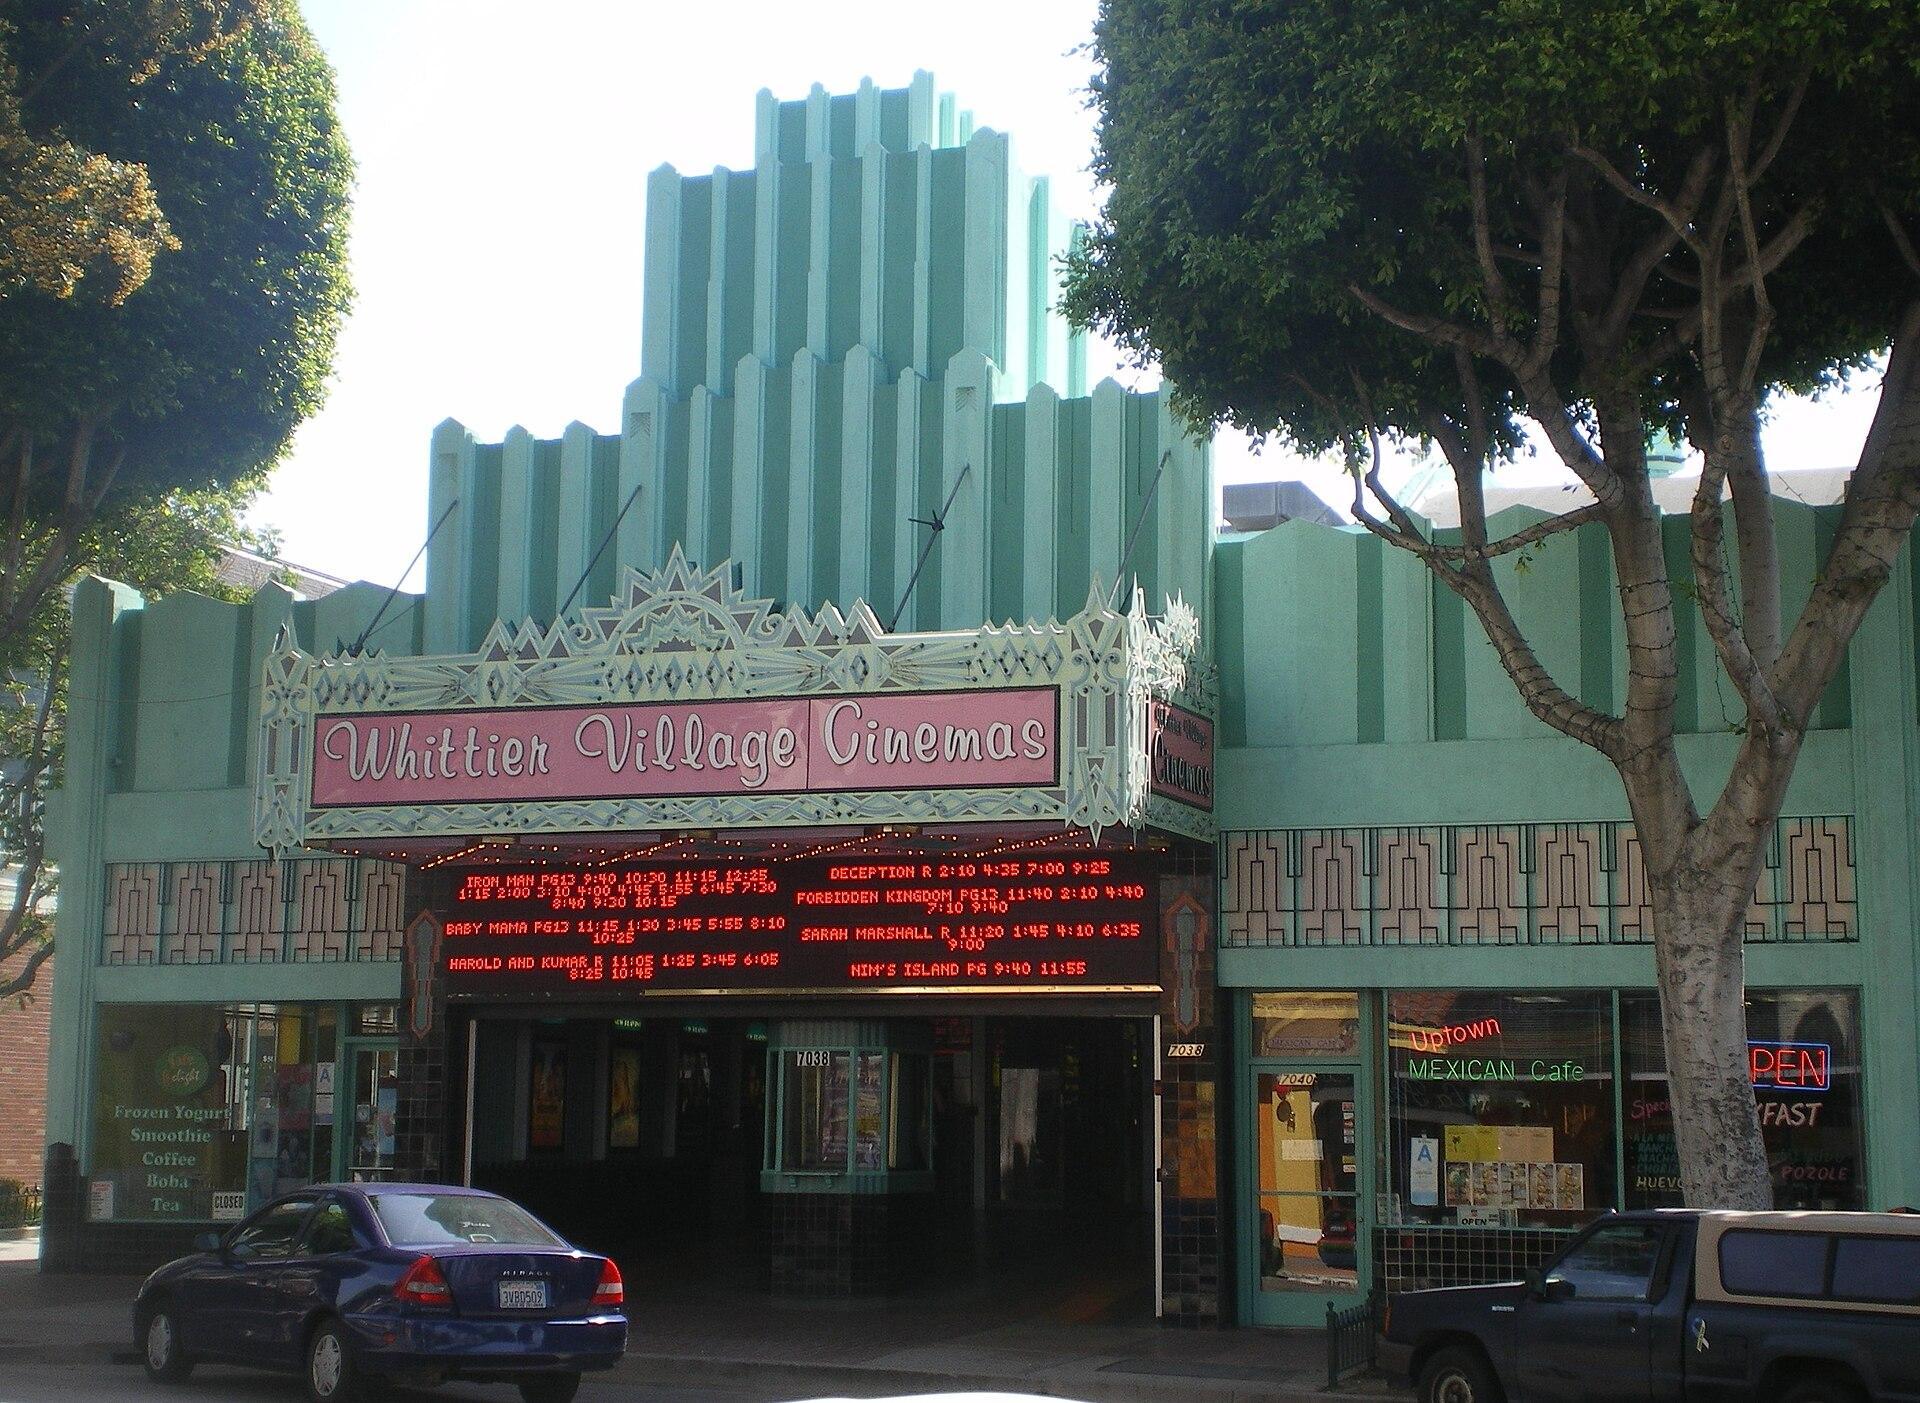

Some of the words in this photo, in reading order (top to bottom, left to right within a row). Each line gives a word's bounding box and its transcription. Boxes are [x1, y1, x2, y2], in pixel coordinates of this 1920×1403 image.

[323, 720, 549, 781] Whittier
[574, 713, 796, 788] Village
[823, 700, 1048, 765] Cinemas
[1154, 730, 1212, 797] Cinemas
[467, 876, 499, 888] IRON
[507, 875, 534, 887] MAN
[541, 874, 576, 886] PG13
[584, 873, 617, 885] 9:40
[625, 872, 666, 884] 10:30
[675, 870, 717, 882] 11:15
[726, 869, 768, 881] 12:25
[830, 866, 915, 880] DECEPTION
[921, 866, 932, 878] R
[939, 865, 976, 878] 2:10
[983, 864, 1020, 876] 4:35
[1026, 862, 1065, 875] 7:00
[1072, 861, 1110, 875] 9:25
[459, 888, 491, 899] 1:15
[498, 888, 530, 899] 2:00
[537, 886, 570, 898] 3:10
[577, 885, 610, 897] 4:00
[617, 884, 652, 896] 4:45
[659, 883, 693, 895] 5:55
[700, 882, 735, 894] 6:45
[742, 881, 777, 893] 7:30
[797, 891, 879, 905] FORBIDDEN
[886, 889, 953, 903] KINGDOM
[960, 888, 998, 902] PG13
[1008, 887, 1053, 901] 11:40
[1060, 886, 1098, 900] 2:10
[1104, 885, 1143, 899] 4:40
[552, 898, 586, 909] 8:40
[593, 897, 626, 908] 9:30
[635, 895, 677, 908] 10:15
[927, 902, 964, 914] 7:10
[971, 900, 1008, 913] 9:40
[446, 922, 483, 935] BABY
[489, 922, 528, 934] MAMA
[534, 921, 569, 934] PG13
[577, 920, 619, 932] 11:15
[627, 920, 660, 931] 1:30
[667, 919, 702, 931] 3:45
[708, 918, 743, 930] 5:55
[750, 917, 785, 930] 8:10
[801, 927, 849, 941] SARAH
[855, 926, 933, 940] MARSHALL
[941, 926, 951, 939] R
[960, 925, 1005, 938] 11:20
[1013, 924, 1049, 938] 1:45
[1056, 924, 1094, 937] 4:10
[1102, 923, 1141, 937] 6:35
[592, 931, 635, 944] 10:25
[948, 938, 985, 951] 9:00
[449, 957, 502, 970] HAROLD
[508, 957, 535, 970] AND
[541, 956, 588, 969] KUMAR
[594, 955, 603, 968] R
[612, 955, 654, 967] 11:05
[662, 954, 695, 967] 1:25
[702, 953, 737, 966] 3:45
[744, 953, 779, 966] 6:05
[851, 963, 897, 977] NIM'S
[903, 963, 960, 977] ISLAND
[967, 962, 987, 976] PG
[994, 961, 1031, 975] 9:40
[1040, 961, 1087, 975] 11:55
[569, 968, 603, 980] 8:25
[612, 967, 653, 979] 10:45
[1411, 1018, 1501, 1052] Uptown
[797, 1051, 829, 1066] 7038
[1169, 1045, 1203, 1056] 7038
[1409, 1059, 1515, 1081] MEXICAN
[1531, 1060, 1585, 1081] Cafe
[1752, 1049, 1826, 1086] PEN
[1281, 1074, 1314, 1085] 7040
[114, 1104, 169, 1119] Frozen
[174, 1104, 232, 1122] Yogurt
[130, 1127, 212, 1143] Smoothie
[142, 1152, 196, 1166] Coffee
[1417, 1145, 1432, 1162] A
[146, 1173, 190, 1188] Boba
[1780, 1167, 1849, 1181] POZOLE
[1636, 1176, 1686, 1189] HUEVO
[151, 1197, 180, 1212] Tea
[214, 1195, 244, 1210] CLOSED
[1461, 1218, 1487, 1226] OPEN
